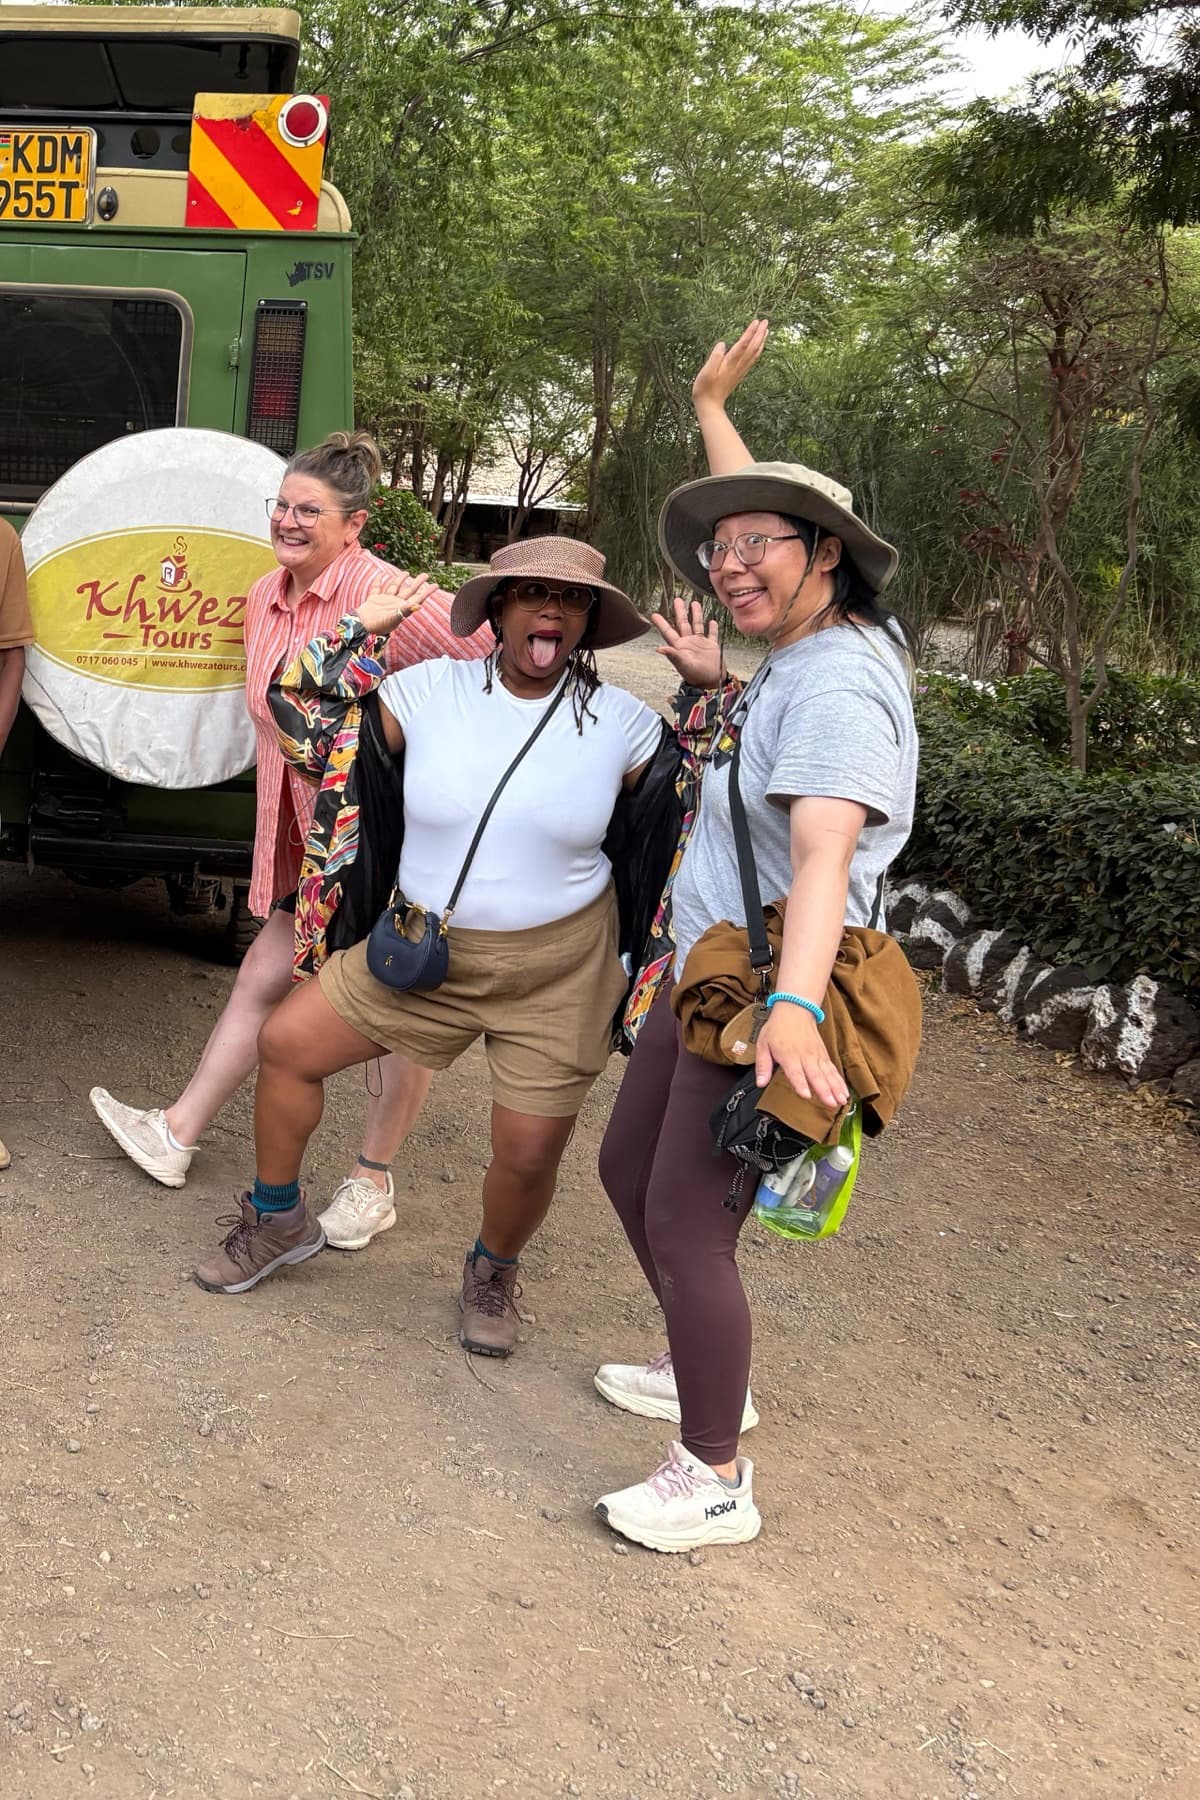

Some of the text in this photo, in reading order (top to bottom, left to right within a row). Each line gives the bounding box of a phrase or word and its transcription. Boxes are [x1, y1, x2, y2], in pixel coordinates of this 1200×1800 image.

[12, 134, 83, 174] KDM
[303, 262, 335, 280] TSV
[76, 574, 248, 628] Khwez
[139, 624, 213, 650] Tours
[76, 655, 100, 665] 0717
[101, 656, 120, 666] 060
[121, 657, 138, 666] 045
[704, 1499, 737, 1521] HOKA
